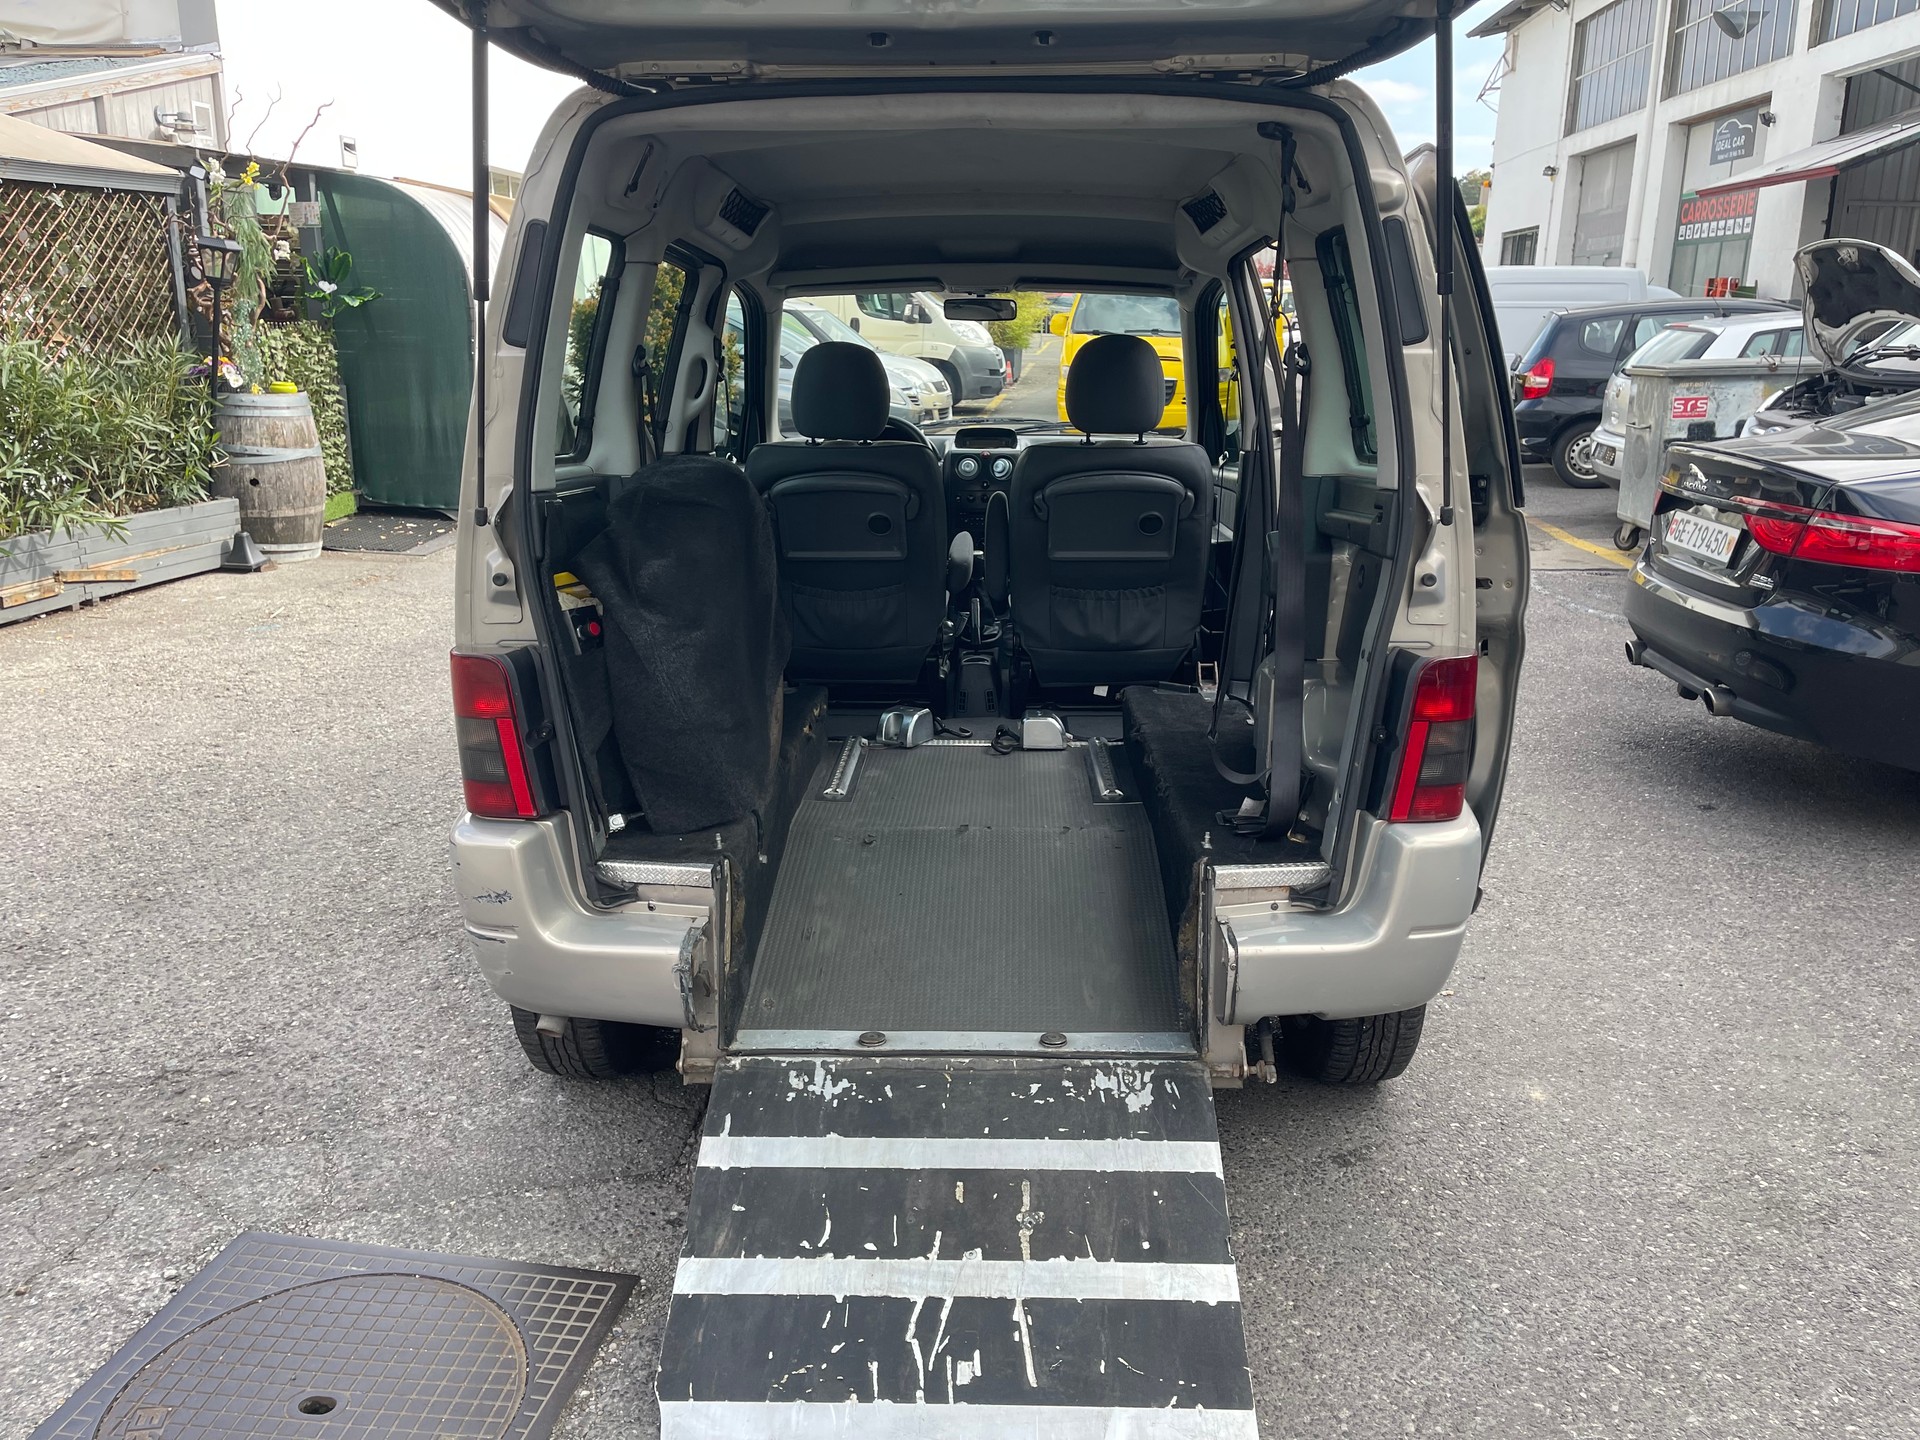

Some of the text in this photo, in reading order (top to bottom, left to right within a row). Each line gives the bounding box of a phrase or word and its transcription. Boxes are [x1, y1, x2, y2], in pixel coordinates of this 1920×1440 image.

[1715, 138, 1731, 151] IDEAL
[1732, 135, 1746, 148] CAR
[1681, 191, 1756, 224] CARROSSERIE
[1681, 481, 1707, 492] JAGUAR
